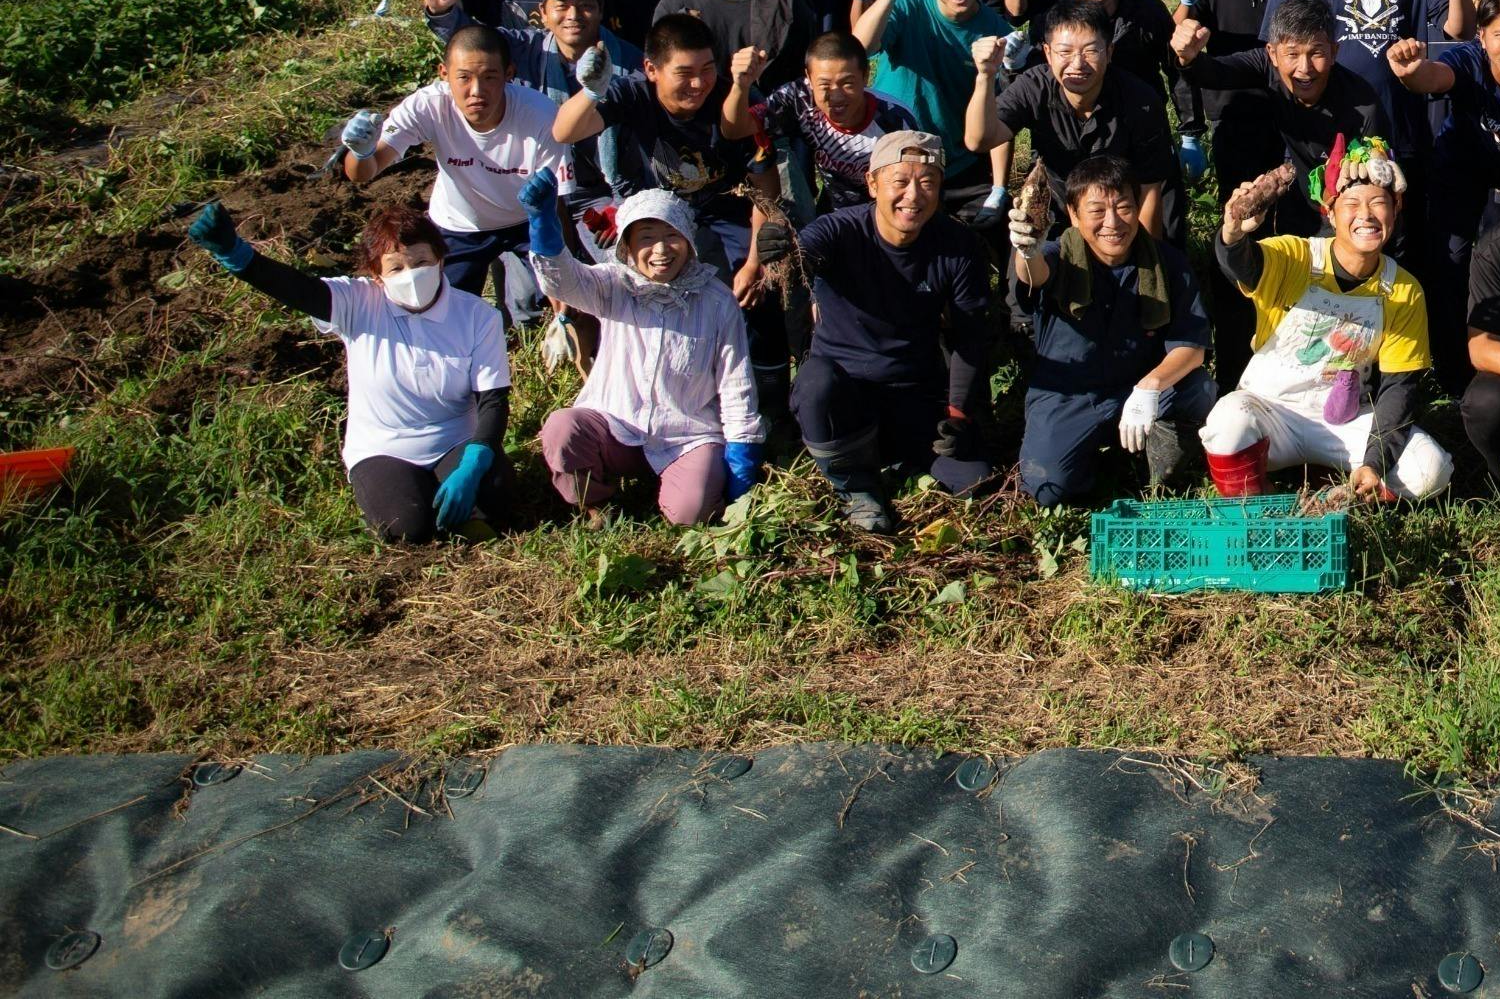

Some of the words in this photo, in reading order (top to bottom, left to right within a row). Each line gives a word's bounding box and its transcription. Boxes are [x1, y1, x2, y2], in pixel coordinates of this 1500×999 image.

[1348, 33, 1364, 41] IMF
[1364, 33, 1398, 41] BANDITS
[559, 161, 574, 183] 18
